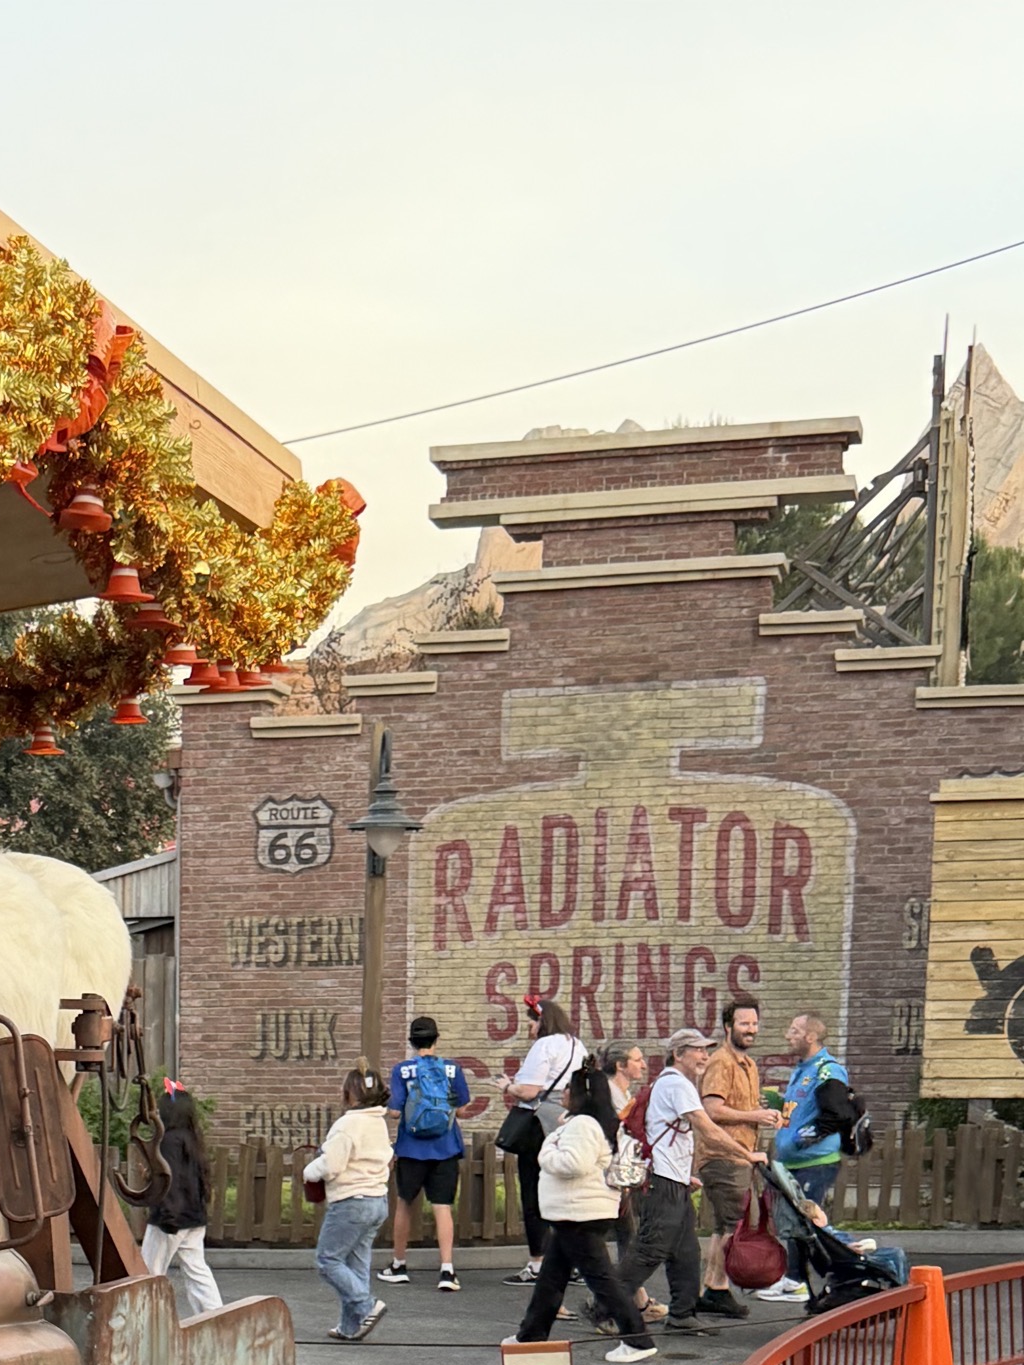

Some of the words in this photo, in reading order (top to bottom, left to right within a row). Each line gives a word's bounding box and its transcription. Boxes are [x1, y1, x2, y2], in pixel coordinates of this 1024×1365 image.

[269, 807, 320, 820] ROUTE
[268, 832, 318, 865] 66
[434, 805, 812, 951] RADIATOR
[227, 916, 364, 966] WESTERN
[485, 943, 760, 1041] SPRINGS
[248, 1009, 337, 1061] JUNK
